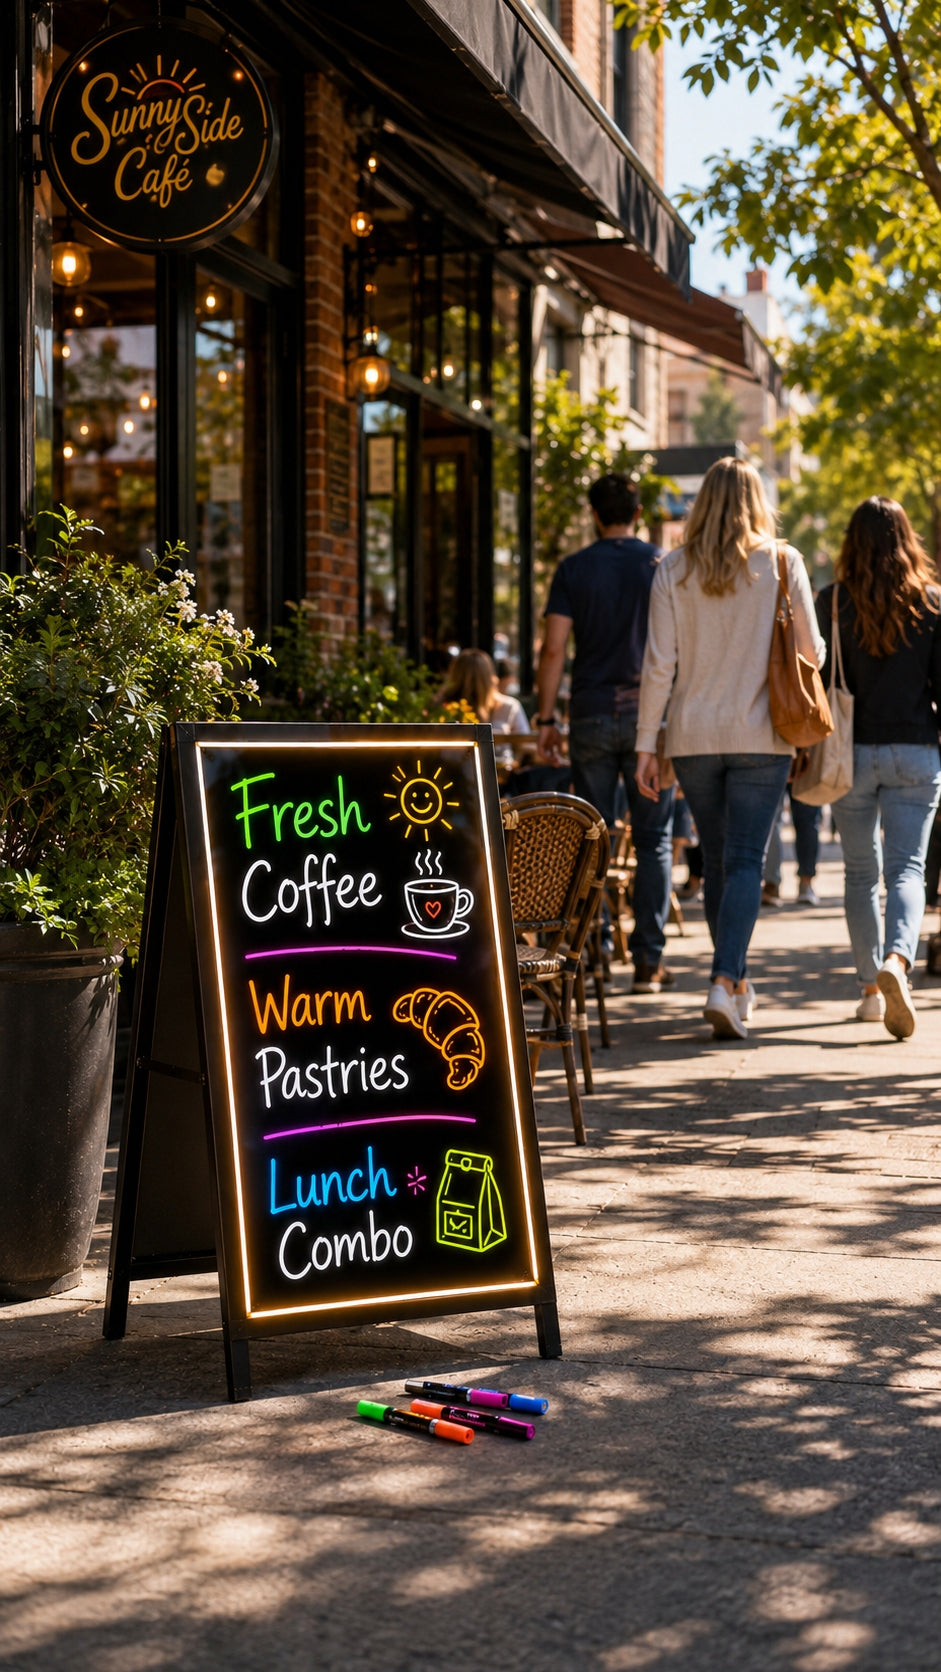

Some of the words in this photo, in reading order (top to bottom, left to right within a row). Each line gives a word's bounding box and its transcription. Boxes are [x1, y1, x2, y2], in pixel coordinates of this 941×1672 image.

[114, 146, 193, 208] Café
[230, 772, 371, 849] Fresh
[241, 853, 382, 927] Coffee
[248, 974, 371, 1034] Warm
[254, 1045, 409, 1108] Pastries
[270, 1146, 397, 1215] Lunch
[278, 1212, 413, 1280] Combo
